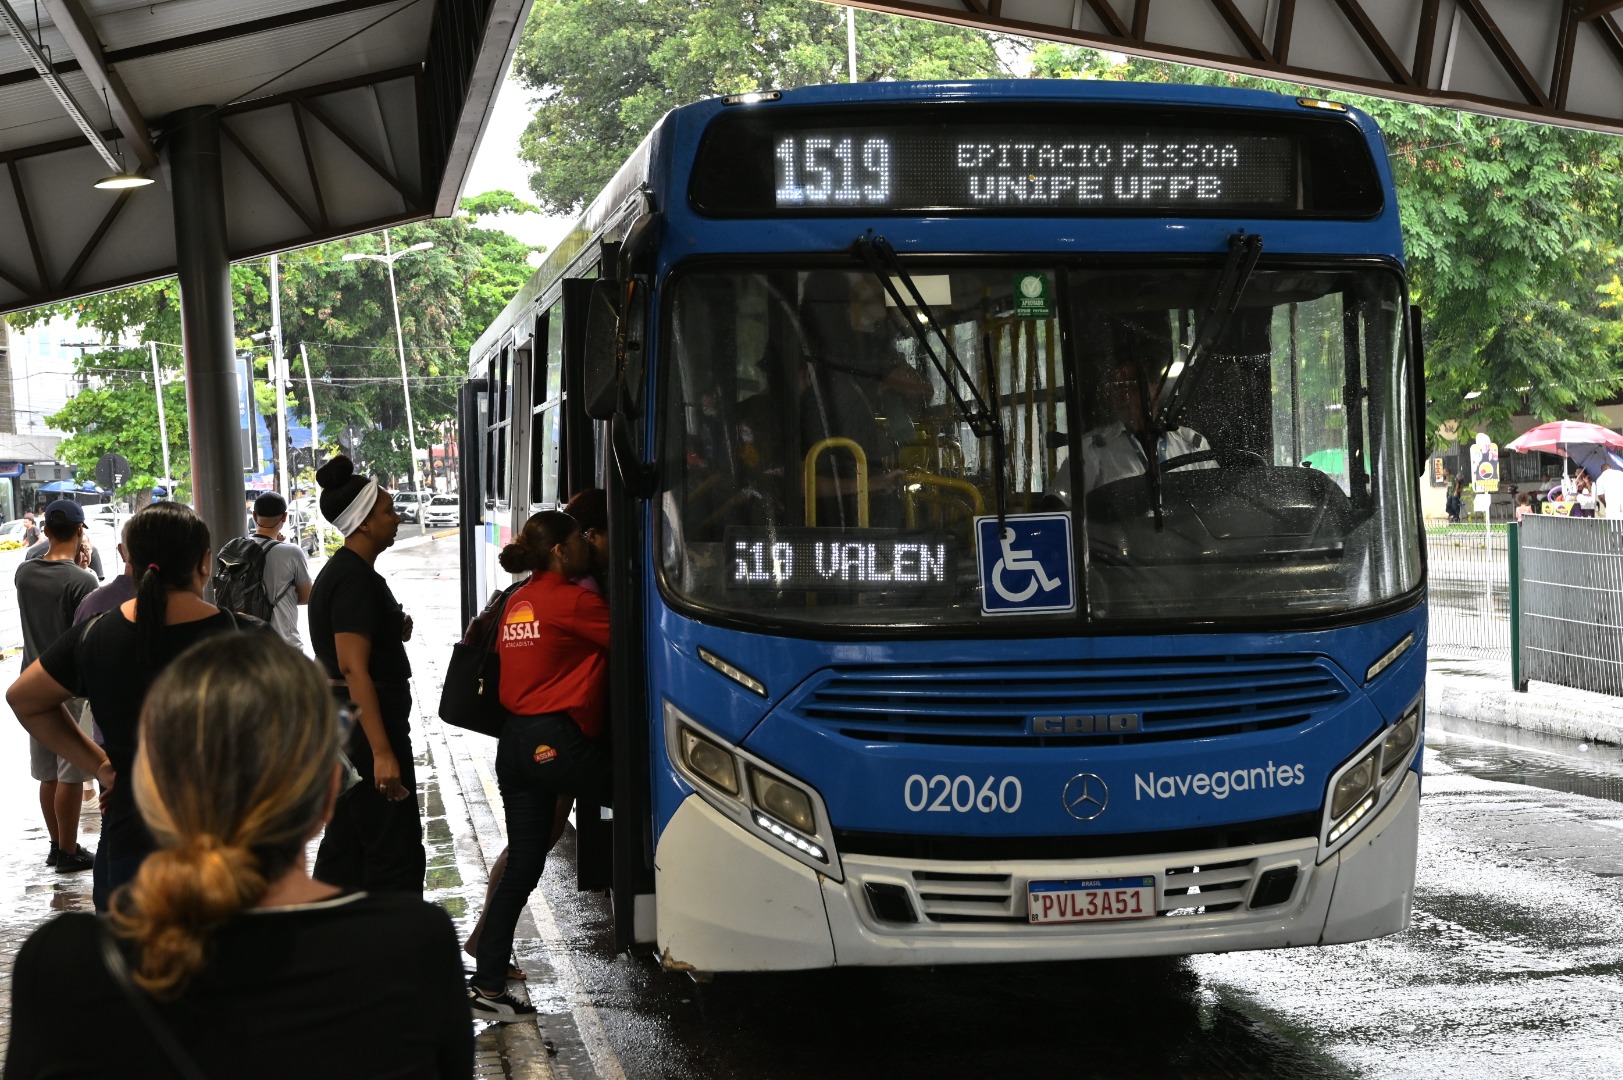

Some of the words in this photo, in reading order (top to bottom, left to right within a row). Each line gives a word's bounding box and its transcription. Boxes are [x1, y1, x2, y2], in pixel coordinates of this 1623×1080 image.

[776, 138, 890, 203] 1519
[957, 143, 1112, 168] EPITACIO
[1122, 144, 1240, 168] PESSOA
[969, 175, 1104, 201] UNIPE
[1114, 175, 1222, 200] UFPB
[815, 541, 946, 582] VALEN
[1033, 713, 1139, 734] CAIO
[904, 774, 1023, 814] 02060
[1134, 760, 1306, 801] Navegantes
[1041, 890, 1143, 919] PVL3A51
